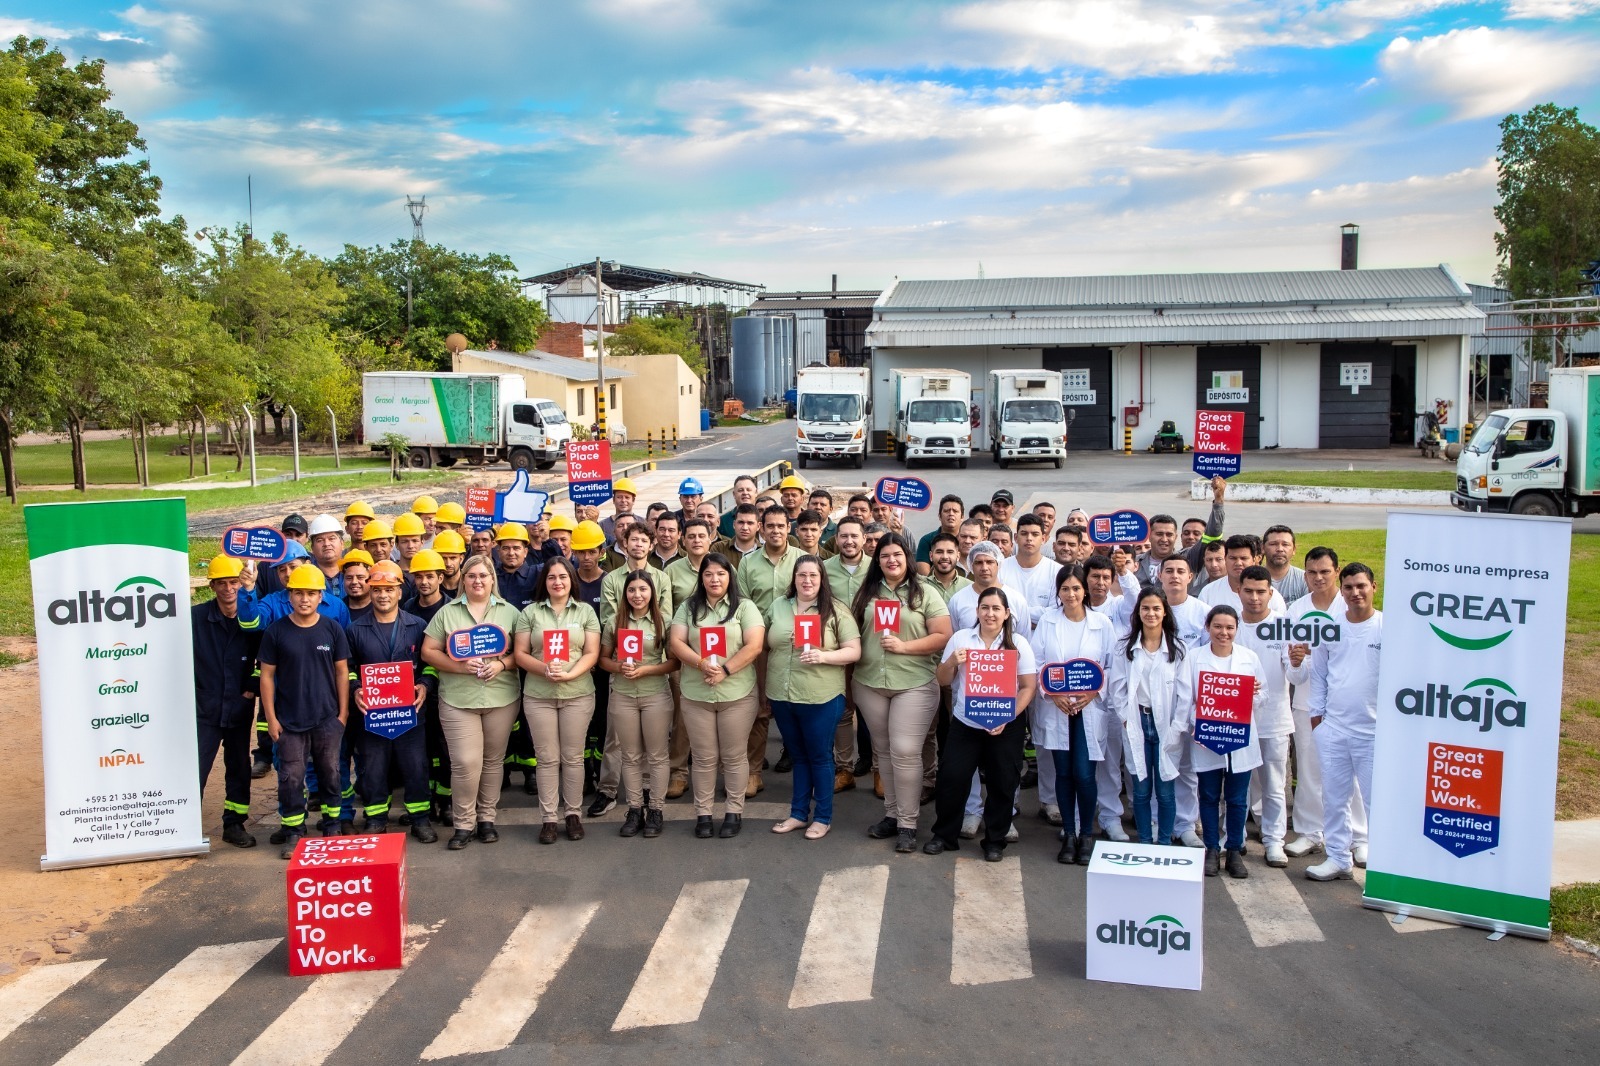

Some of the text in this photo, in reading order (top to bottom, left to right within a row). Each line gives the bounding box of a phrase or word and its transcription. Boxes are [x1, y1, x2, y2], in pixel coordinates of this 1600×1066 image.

[1062, 393, 1088, 401] EPÓSITO
[1209, 392, 1240, 400] DEPÓSITO
[1199, 412, 1232, 422] Great
[1199, 422, 1231, 431] Place
[1198, 432, 1210, 440] To
[569, 443, 599, 452] Great
[570, 453, 599, 461] Place
[1198, 456, 1236, 464] Certified
[1511, 471, 1538, 481] altaja
[573, 483, 608, 491] Certified
[1404, 559, 1549, 580] Somos una empresa
[48, 586, 176, 628] altaja
[1410, 591, 1535, 624] GREAT
[877, 607, 897, 625] W
[800, 621, 812, 639] T
[1256, 618, 1340, 647] altaja
[549, 633, 563, 655] #
[623, 635, 638, 653] G
[706, 633, 719, 651] P
[86, 643, 147, 660] Margasol
[969, 651, 1004, 661] Great
[365, 665, 400, 675] Great
[970, 662, 1004, 672] Place
[366, 676, 400, 685] Place
[969, 673, 982, 682] To
[1203, 673, 1240, 686] Great
[99, 681, 138, 695] Grasol
[366, 687, 380, 695] To
[1203, 684, 1239, 696] Place
[970, 700, 1011, 709] Certified
[1201, 695, 1215, 705] To
[1395, 683, 1526, 732] altaja
[91, 713, 149, 729] graziella
[370, 709, 411, 720] Certified
[1201, 723, 1245, 735] Certified
[99, 753, 144, 767] INPAL
[1433, 746, 1484, 764] Great
[1433, 761, 1482, 778] Place
[1432, 775, 1450, 789] To
[86, 790, 162, 804] +595 21 338 9466
[60, 798, 187, 816] administracion@altaja.com.py
[74, 808, 174, 824] Planta industrial Villeta
[1432, 813, 1492, 831] Certified
[91, 824, 112, 832] Calle
[130, 820, 152, 828] Calle
[73, 836, 94, 844] Avay
[127, 831, 131, 839] /
[134, 827, 178, 836] Paraguay.
[305, 837, 380, 845] Great
[1445, 831, 1475, 840] 2024-FEB
[304, 844, 376, 852] Place
[1101, 853, 1193, 866] altaja
[294, 876, 372, 898] Great
[297, 900, 372, 920] Place
[296, 925, 325, 943] To
[1096, 920, 1190, 955] altaja
